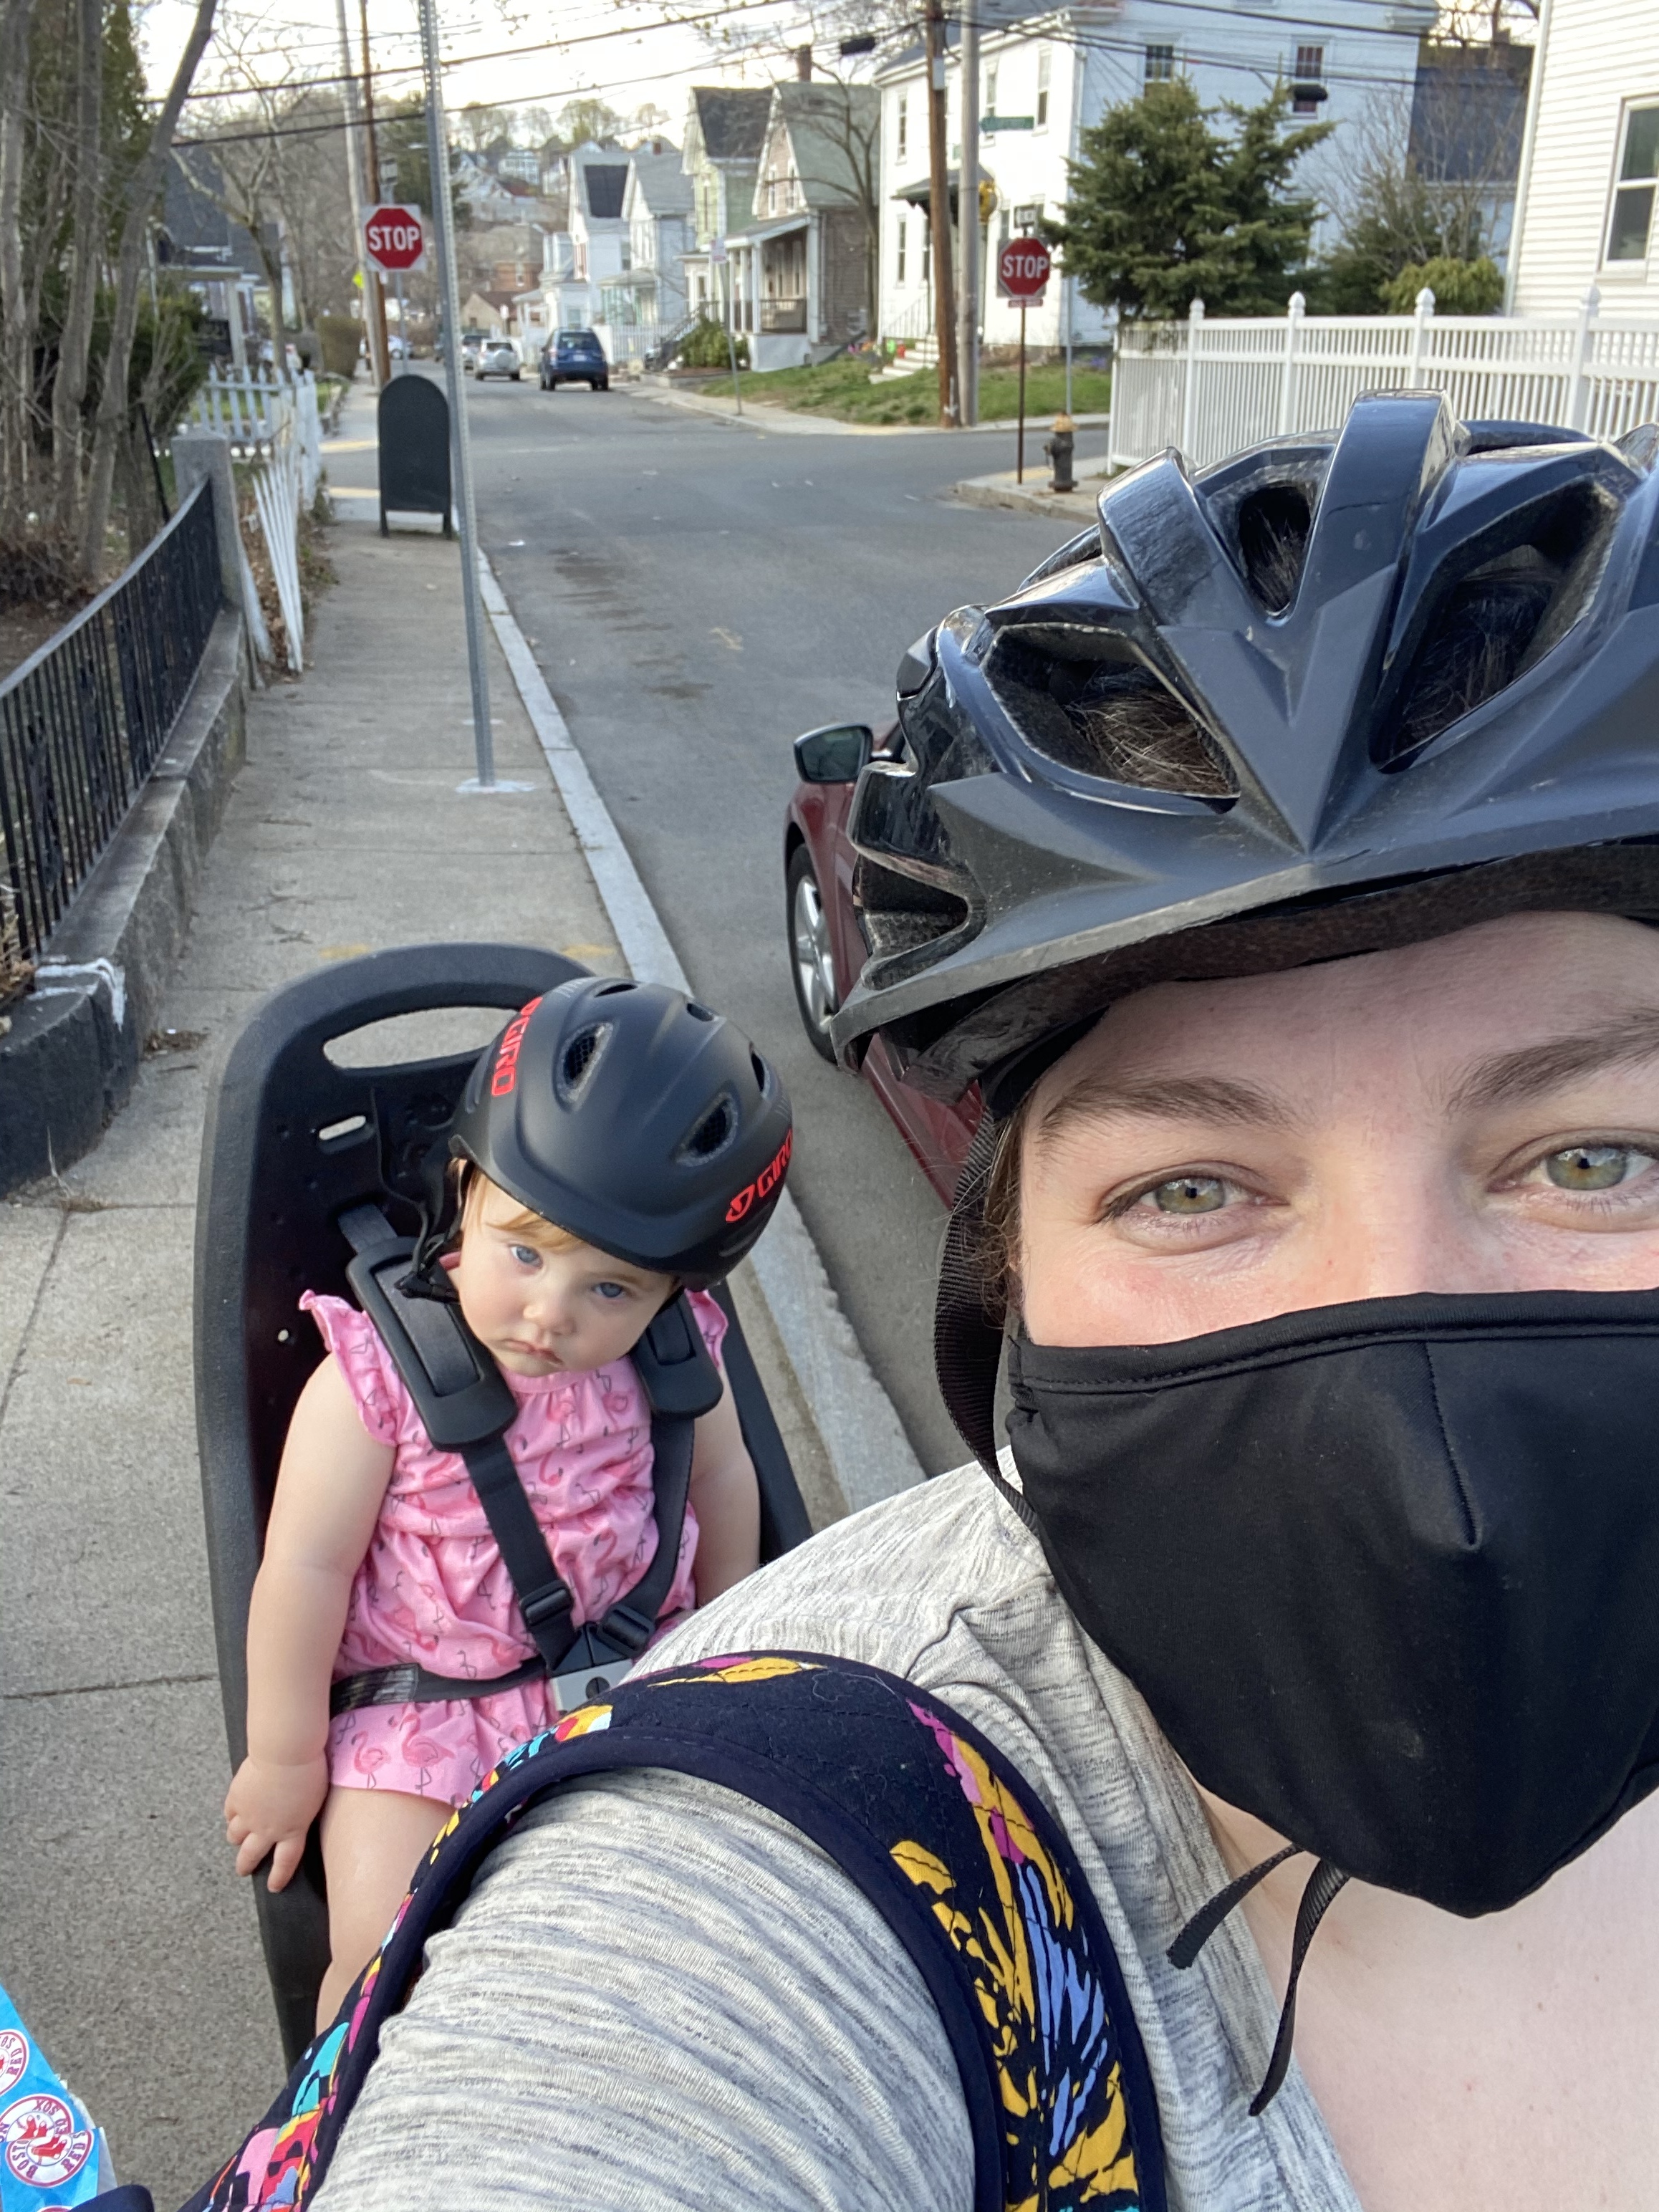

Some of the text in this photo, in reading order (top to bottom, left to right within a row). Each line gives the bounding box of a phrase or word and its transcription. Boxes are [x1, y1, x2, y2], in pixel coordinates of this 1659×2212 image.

[368, 226, 420, 251] STOP
[1002, 254, 1049, 279] STOP
[491, 1016, 530, 1097] GIRO
[0, 2036, 22, 2076] RED SO
[32, 2099, 70, 2135] ED SOX
[12, 2140, 38, 2179] BOSTO
[61, 2143, 86, 2173] RED
